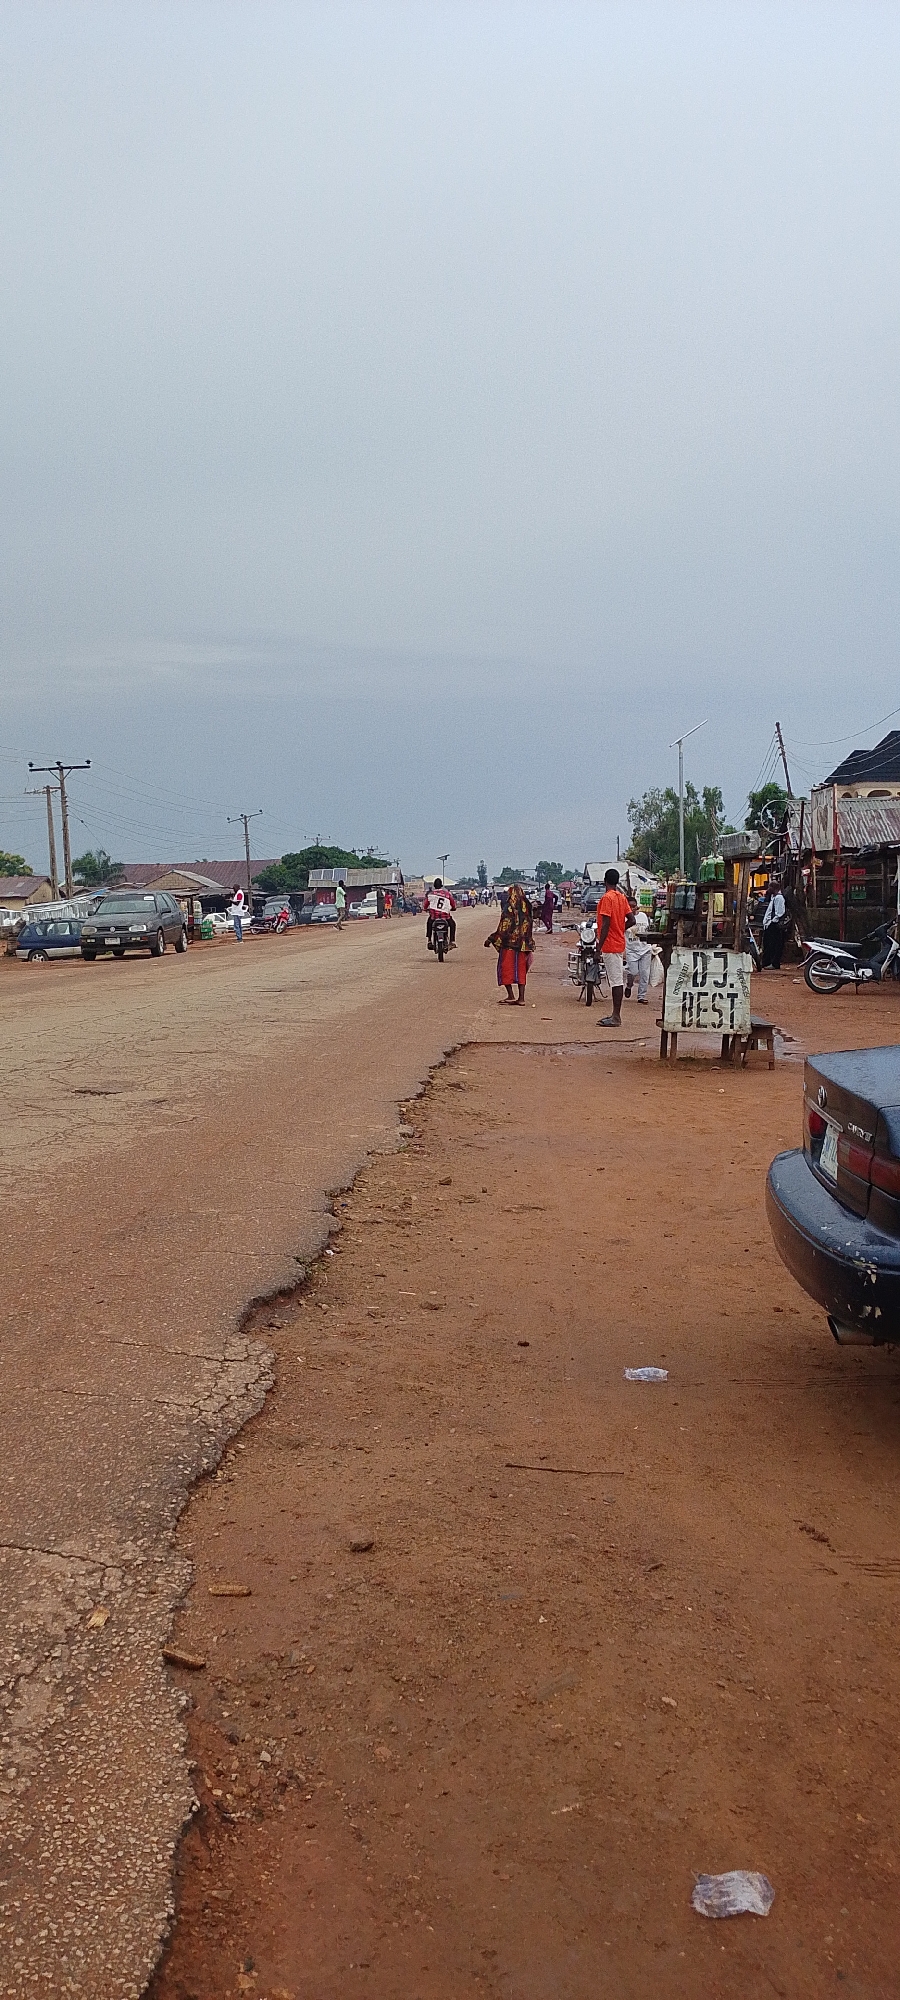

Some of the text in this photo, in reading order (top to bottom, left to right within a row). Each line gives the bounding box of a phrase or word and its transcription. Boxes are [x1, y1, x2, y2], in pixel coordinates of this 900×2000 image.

[437, 898, 445, 909] 6
[692, 951, 735, 989] DJ.
[681, 991, 739, 1030] BEST
